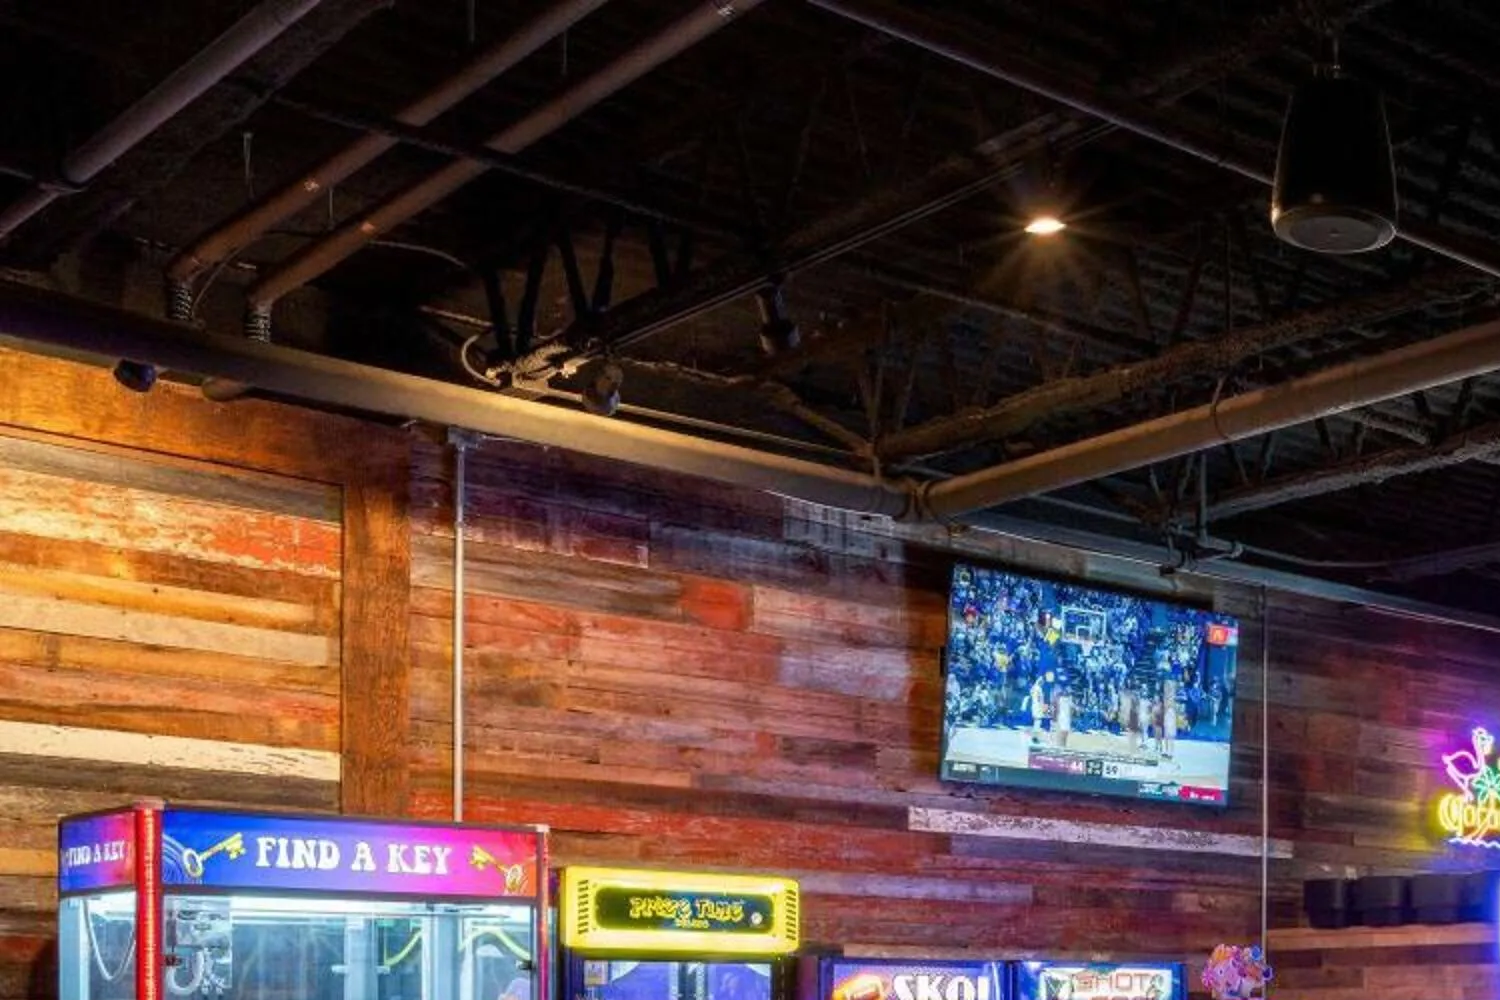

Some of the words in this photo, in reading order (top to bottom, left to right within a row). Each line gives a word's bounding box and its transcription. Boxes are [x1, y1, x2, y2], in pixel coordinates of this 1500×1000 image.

[1105, 764, 1118, 775] 59
[256, 836, 341, 870] FIND
[351, 842, 376, 872] A
[387, 843, 453, 875] KEY
